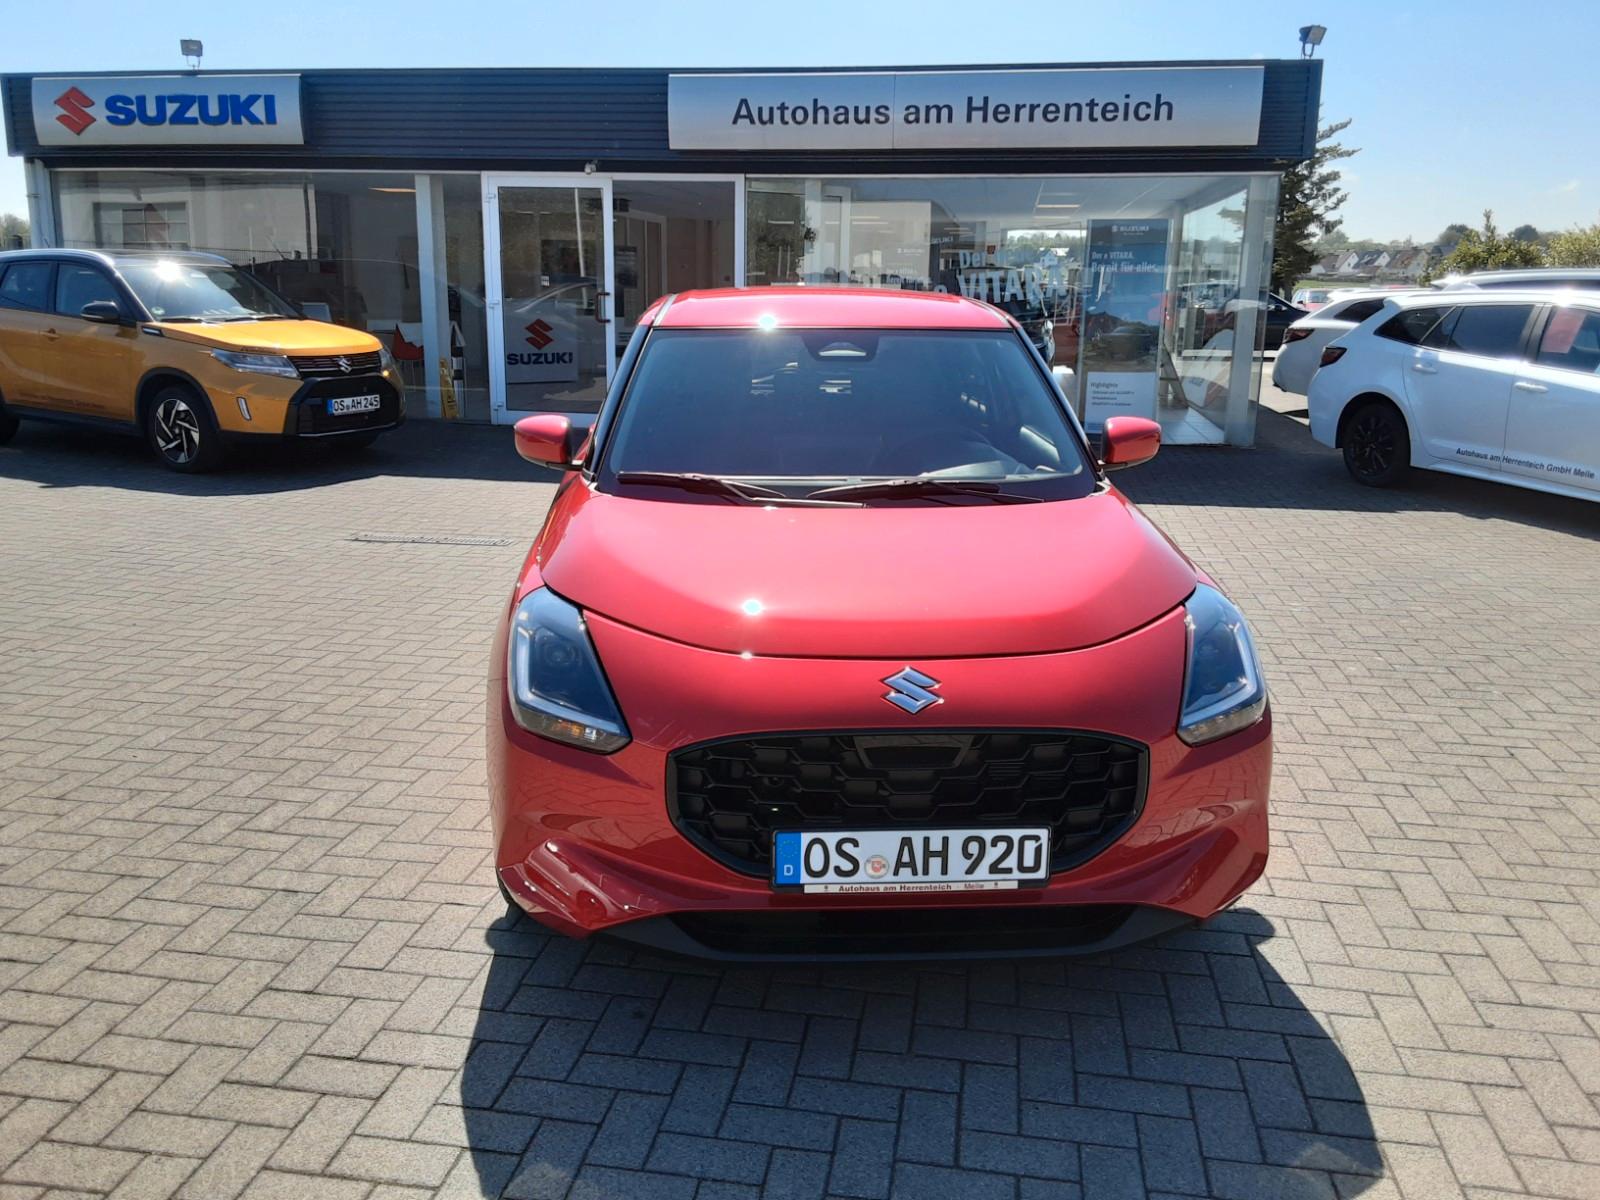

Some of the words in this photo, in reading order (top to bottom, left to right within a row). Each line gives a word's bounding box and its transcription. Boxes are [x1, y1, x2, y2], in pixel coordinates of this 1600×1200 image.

[105, 94, 278, 126] SUZUKI
[731, 98, 891, 126] Autohaus
[903, 103, 954, 125] am
[965, 93, 1175, 125] Herrenteich
[506, 351, 574, 366] SUZUKI
[333, 399, 345, 412] OS
[351, 398, 362, 410] AH
[1456, 447, 1488, 461] Autohaus
[1490, 453, 1501, 463] am
[1502, 455, 1545, 471] Herrenteich
[1546, 463, 1572, 477] GmbH
[803, 837, 860, 878] OS
[893, 836, 950, 877] AH
[961, 834, 1043, 876] 920
[838, 885, 881, 893] Autohaus
[899, 883, 952, 892] Herrenteich
